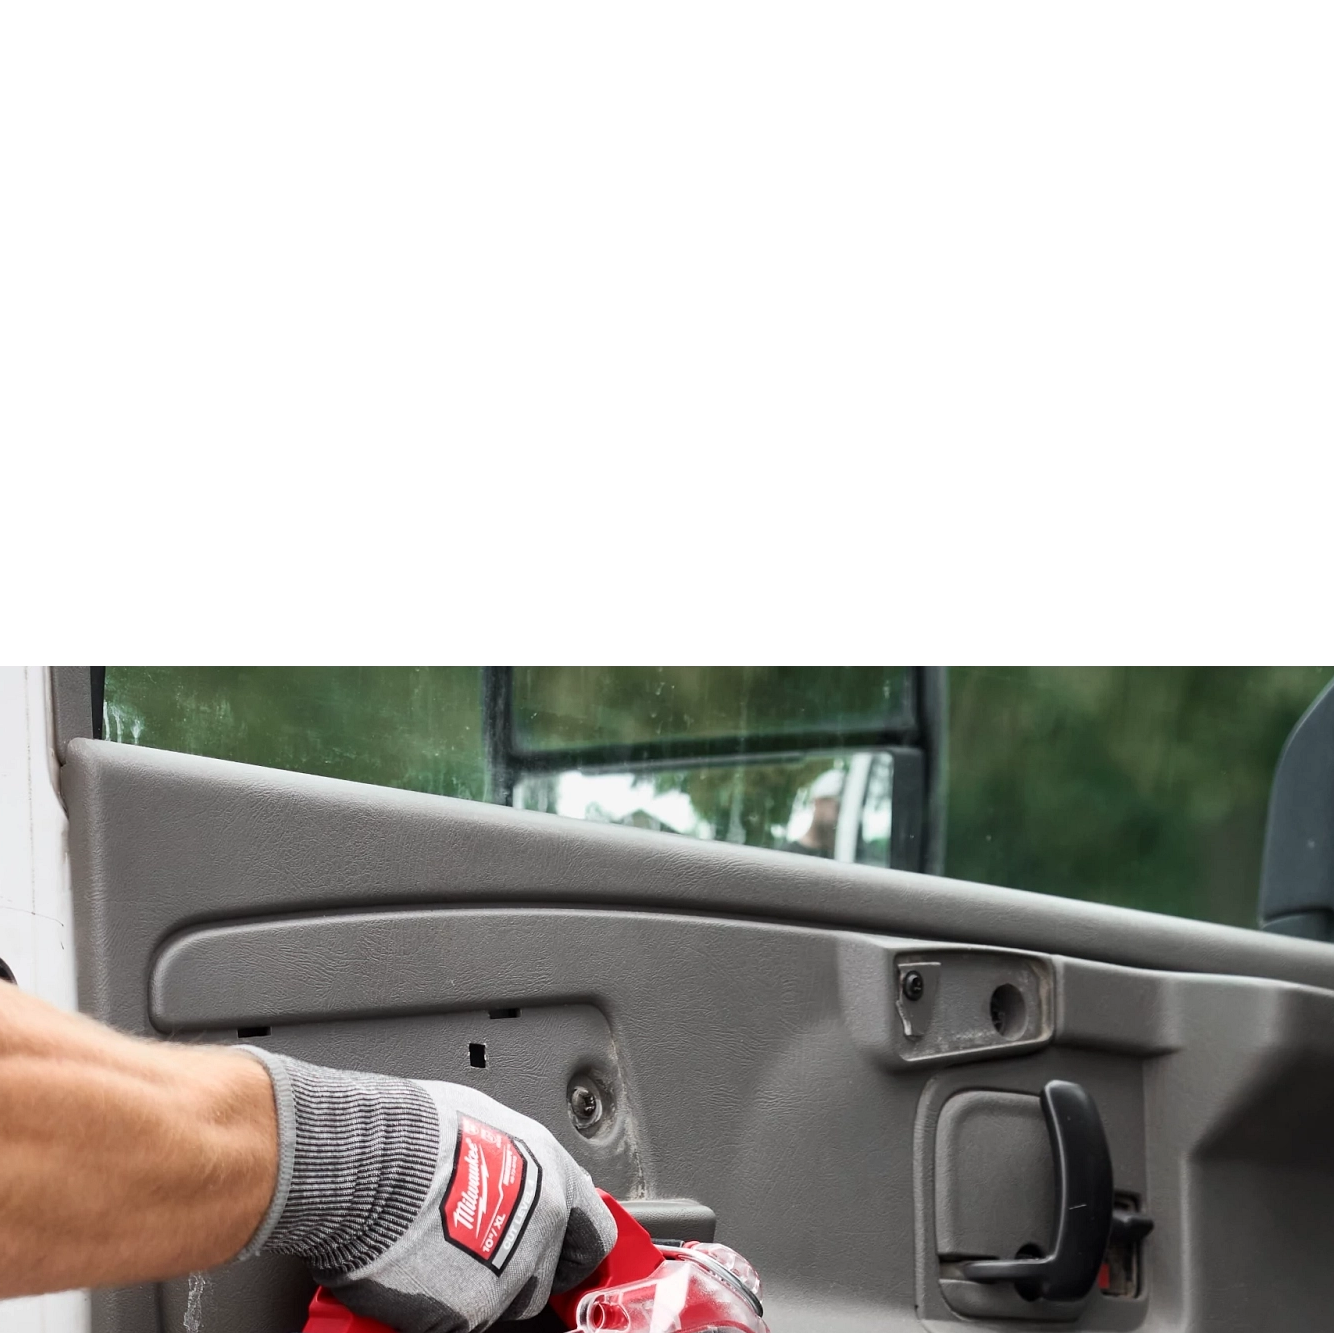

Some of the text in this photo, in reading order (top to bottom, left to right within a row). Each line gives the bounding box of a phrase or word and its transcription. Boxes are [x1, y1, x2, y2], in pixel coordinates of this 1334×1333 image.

[453, 1138, 479, 1230] Milwaukee
[493, 1213, 506, 1230] XL
[503, 1224, 519, 1251] CUT
[516, 1190, 534, 1225] LEVEL
